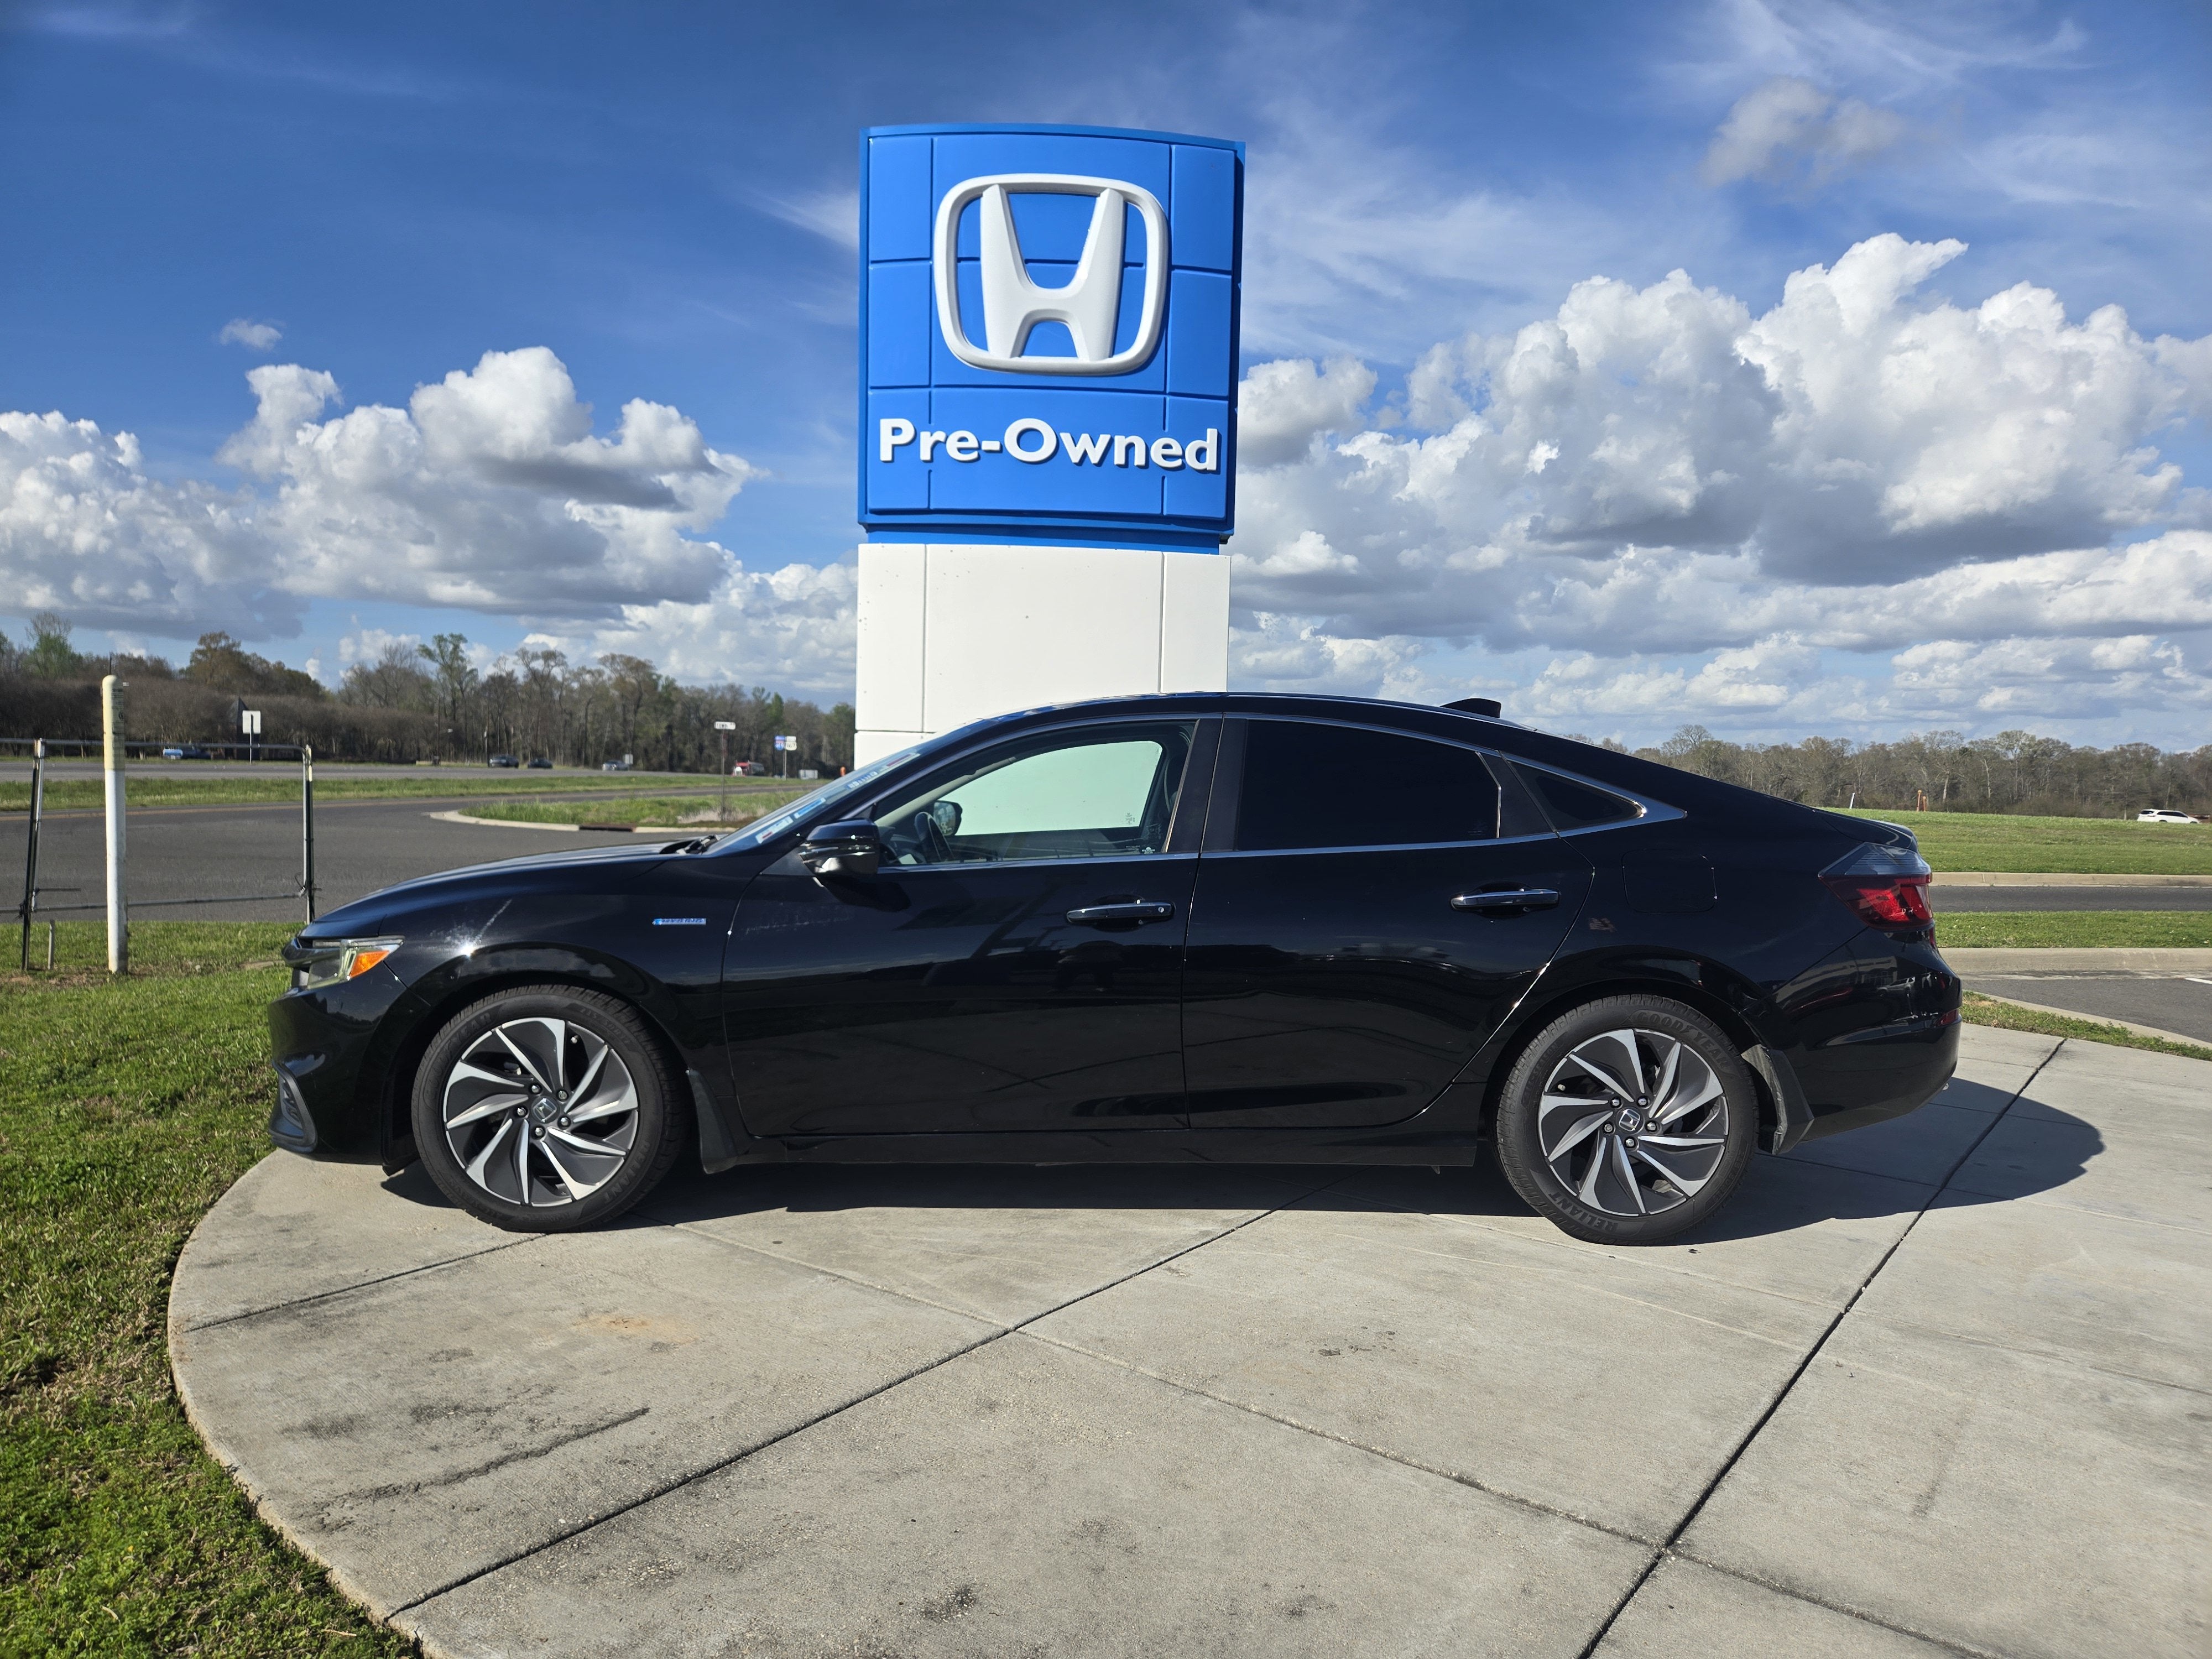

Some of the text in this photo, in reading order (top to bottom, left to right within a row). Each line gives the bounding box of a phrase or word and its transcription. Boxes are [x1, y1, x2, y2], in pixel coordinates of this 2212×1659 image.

[879, 418, 1218, 471] Pre-Owned
[1636, 1012, 1728, 1068] GOODYEAR
[1548, 1192, 1618, 1233] RELIANT
